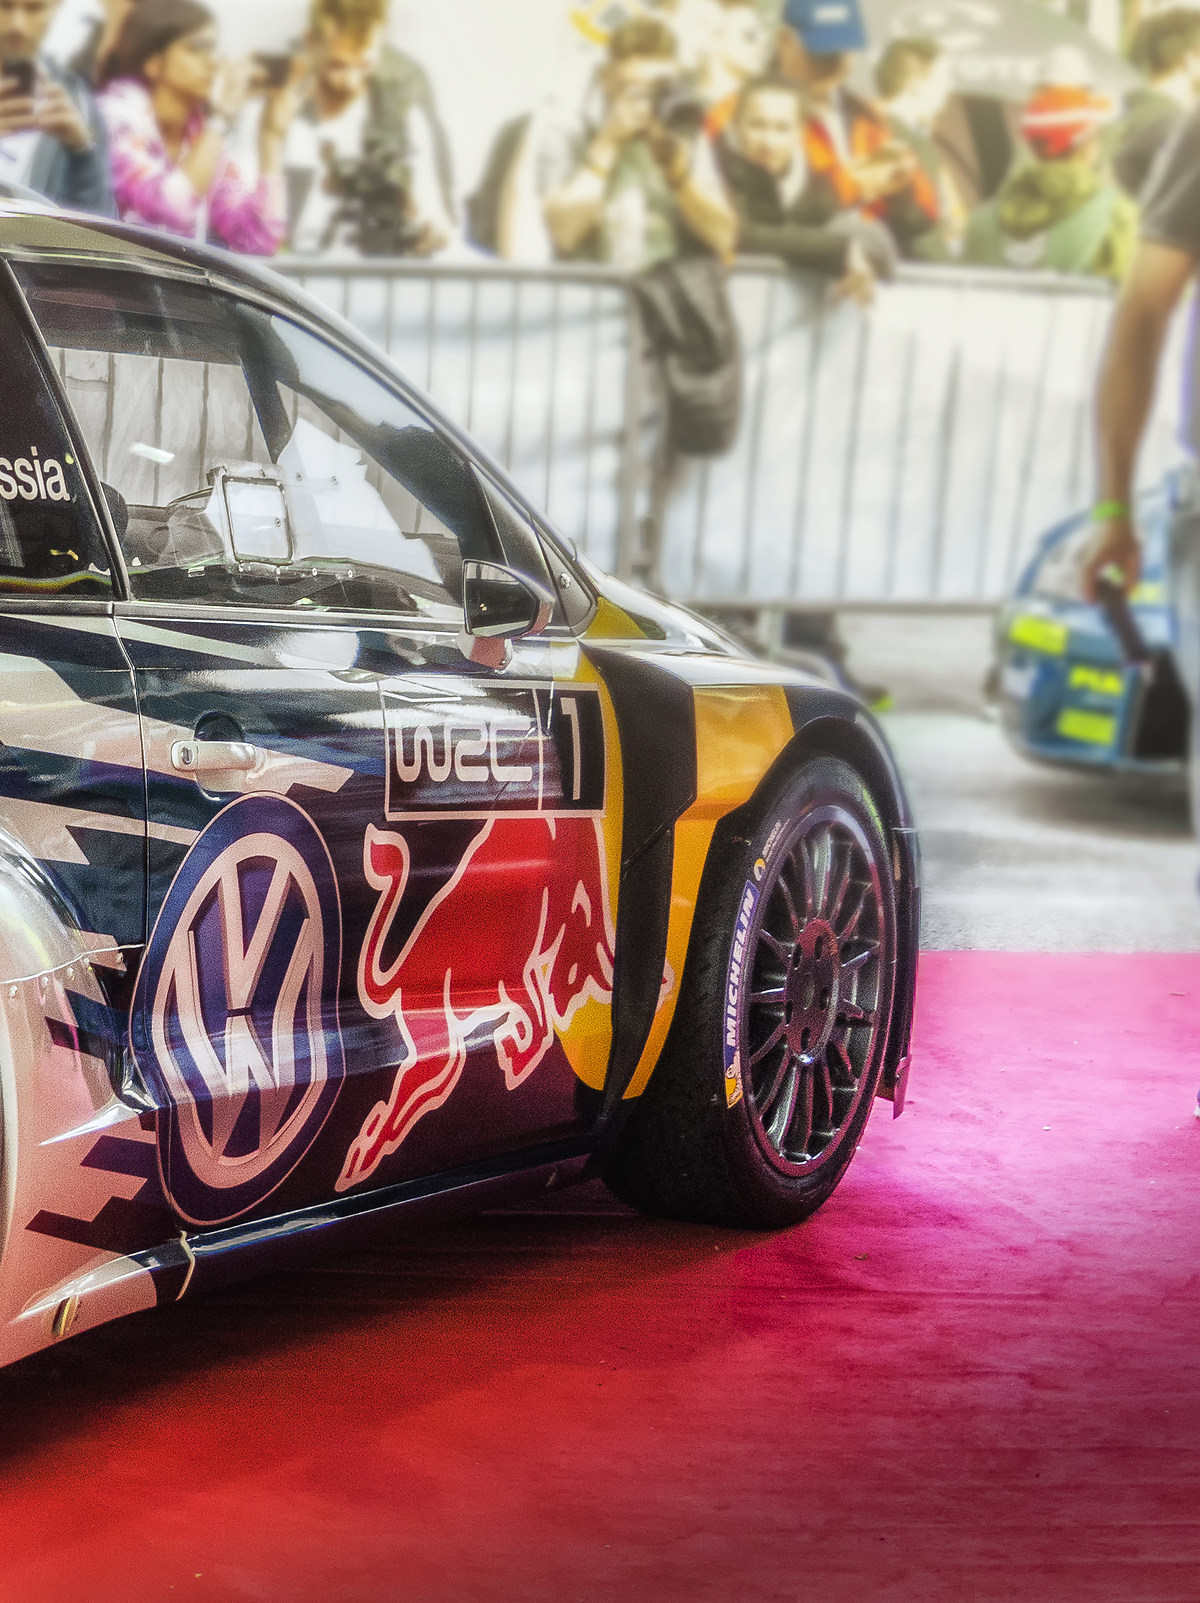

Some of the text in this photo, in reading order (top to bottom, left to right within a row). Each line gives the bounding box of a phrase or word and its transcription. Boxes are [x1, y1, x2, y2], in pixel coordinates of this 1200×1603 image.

[560, 697, 591, 801] 1
[152, 833, 325, 1188] VW
[726, 888, 756, 1047] MICHELIN
